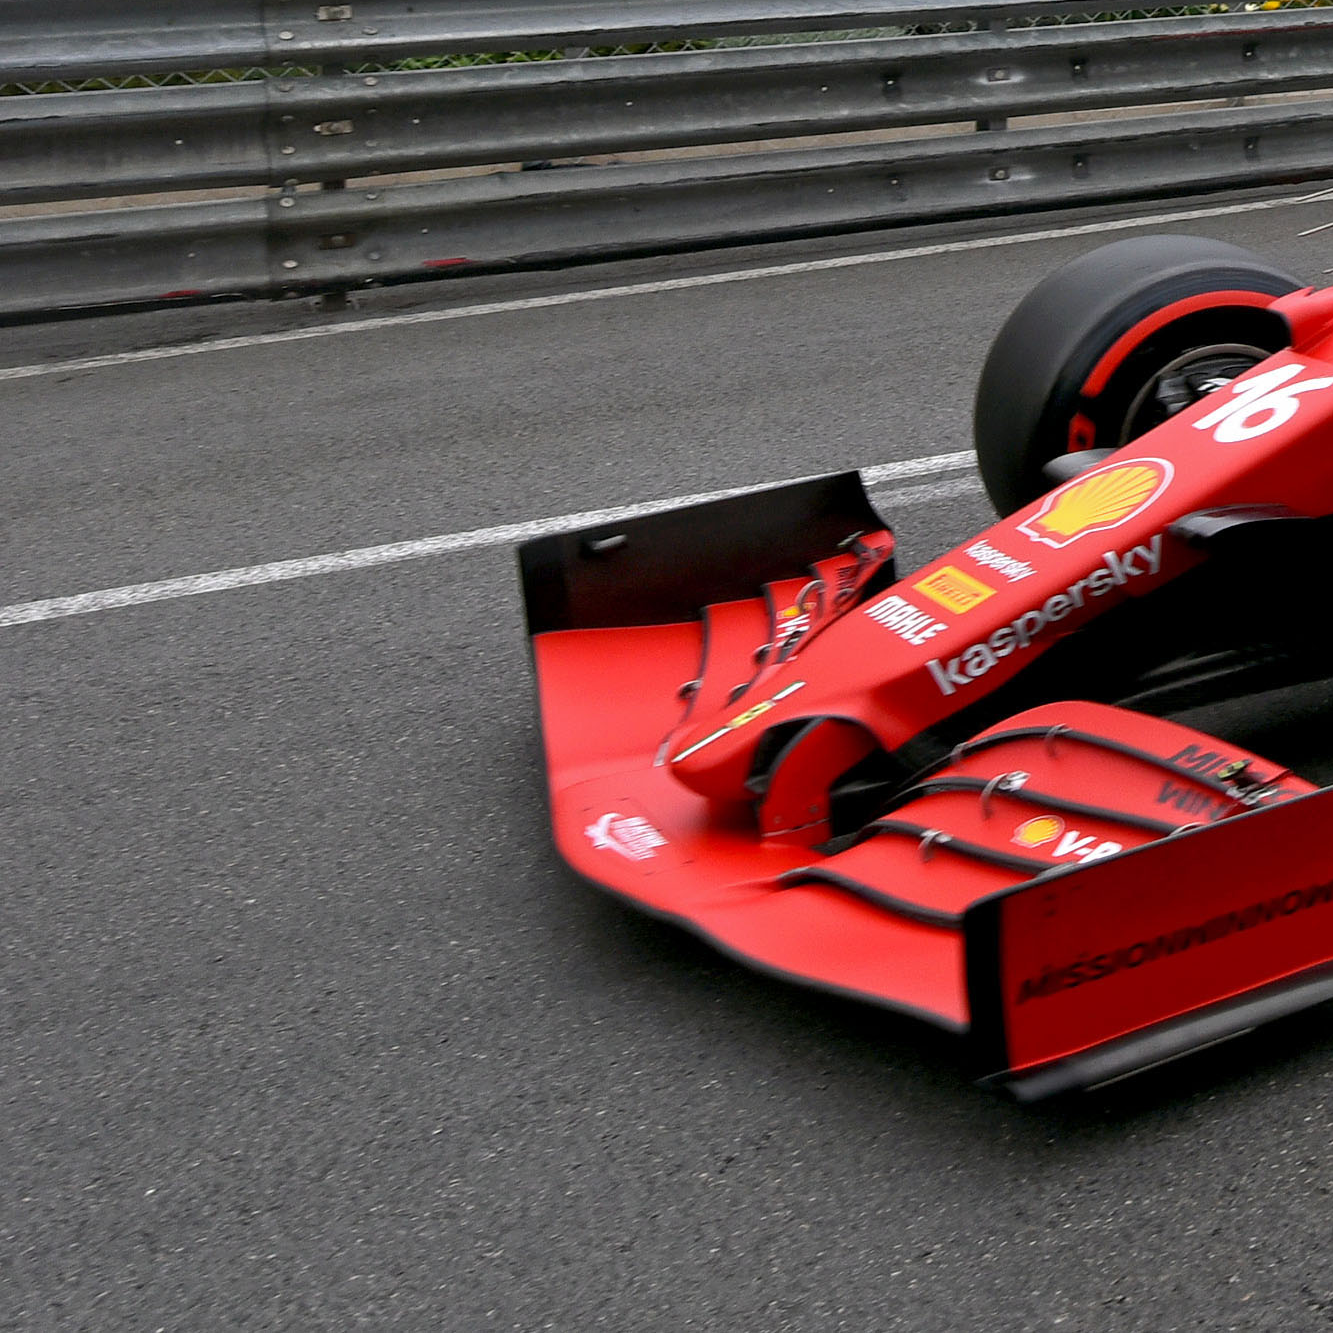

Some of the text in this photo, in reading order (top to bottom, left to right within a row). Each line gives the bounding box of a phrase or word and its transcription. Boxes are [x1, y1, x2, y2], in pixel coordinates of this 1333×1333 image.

[962, 538, 1038, 584] kaspersky
[863, 594, 949, 646] MAHLE
[925, 533, 1163, 695] kaspersky
